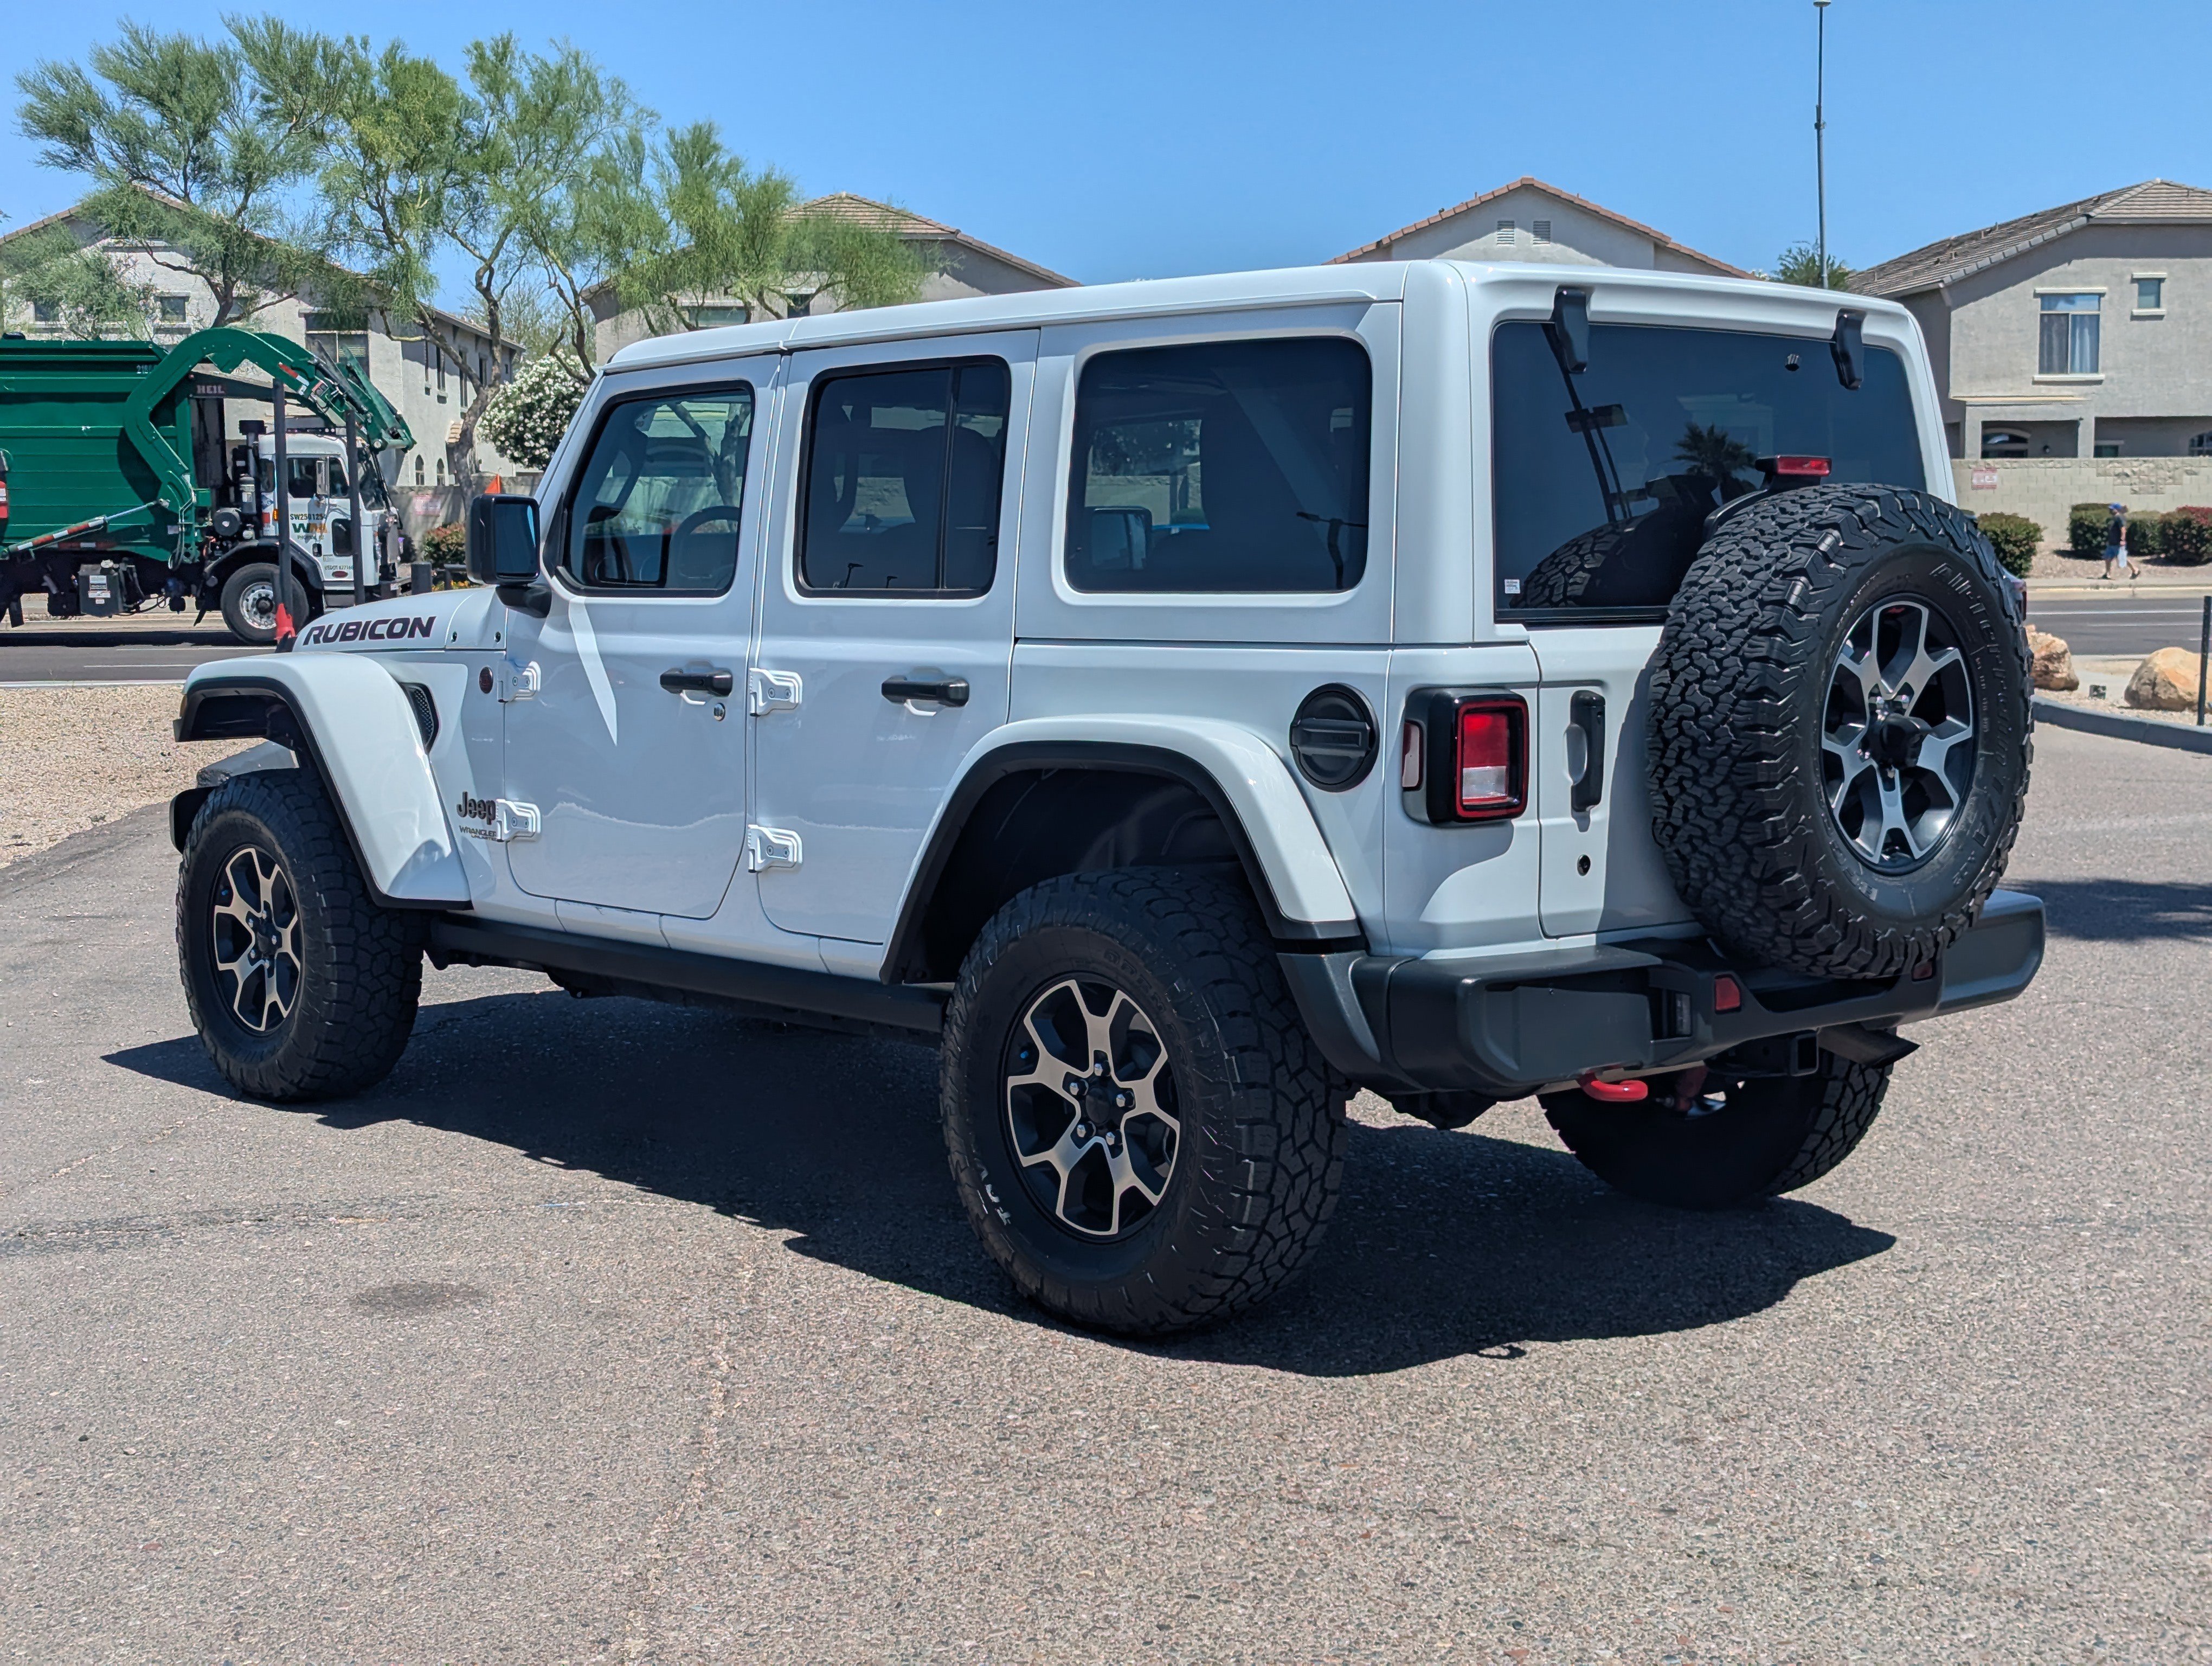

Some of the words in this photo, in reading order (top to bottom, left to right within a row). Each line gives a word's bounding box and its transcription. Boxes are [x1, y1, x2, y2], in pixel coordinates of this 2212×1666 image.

[197, 385, 226, 394] HEIL
[292, 523, 327, 533] WM
[303, 616, 436, 646] RUBICON
[456, 791, 496, 825] Jeep
